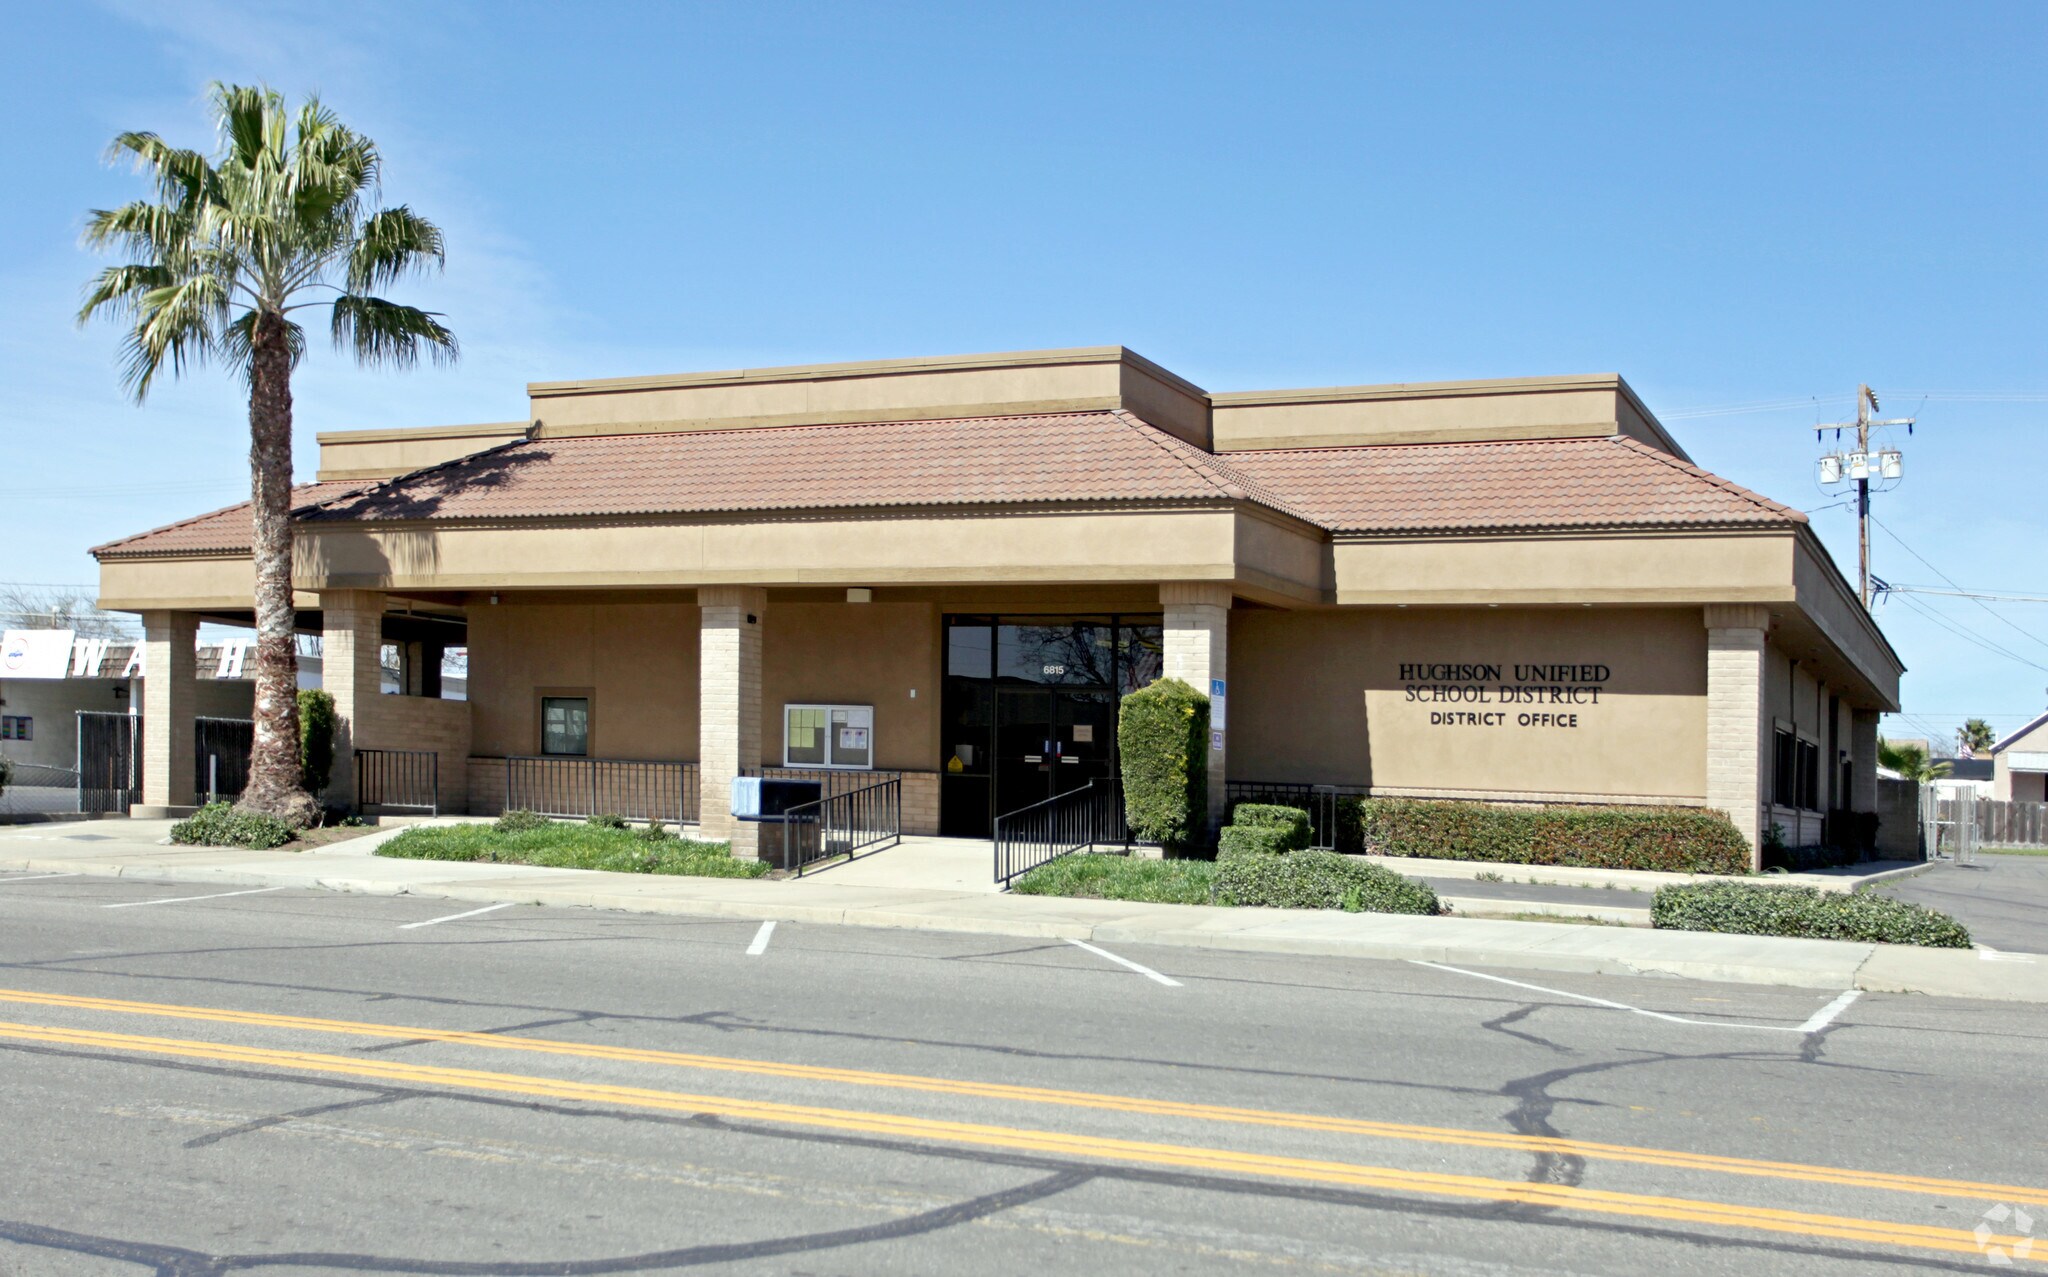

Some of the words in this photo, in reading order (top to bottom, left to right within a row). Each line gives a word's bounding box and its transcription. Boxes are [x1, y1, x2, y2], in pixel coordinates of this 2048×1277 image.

[72, 638, 249, 679] WAH
[1043, 665, 1064, 675] 6815
[1399, 664, 1502, 682] HUGHSON
[1514, 664, 1610, 682] UNIFIED
[1405, 685, 1491, 703] SCHOOL
[1498, 686, 1604, 704] DISTRICT
[1430, 712, 1506, 726] DISTRICT
[1517, 713, 1578, 728] OFFICE
